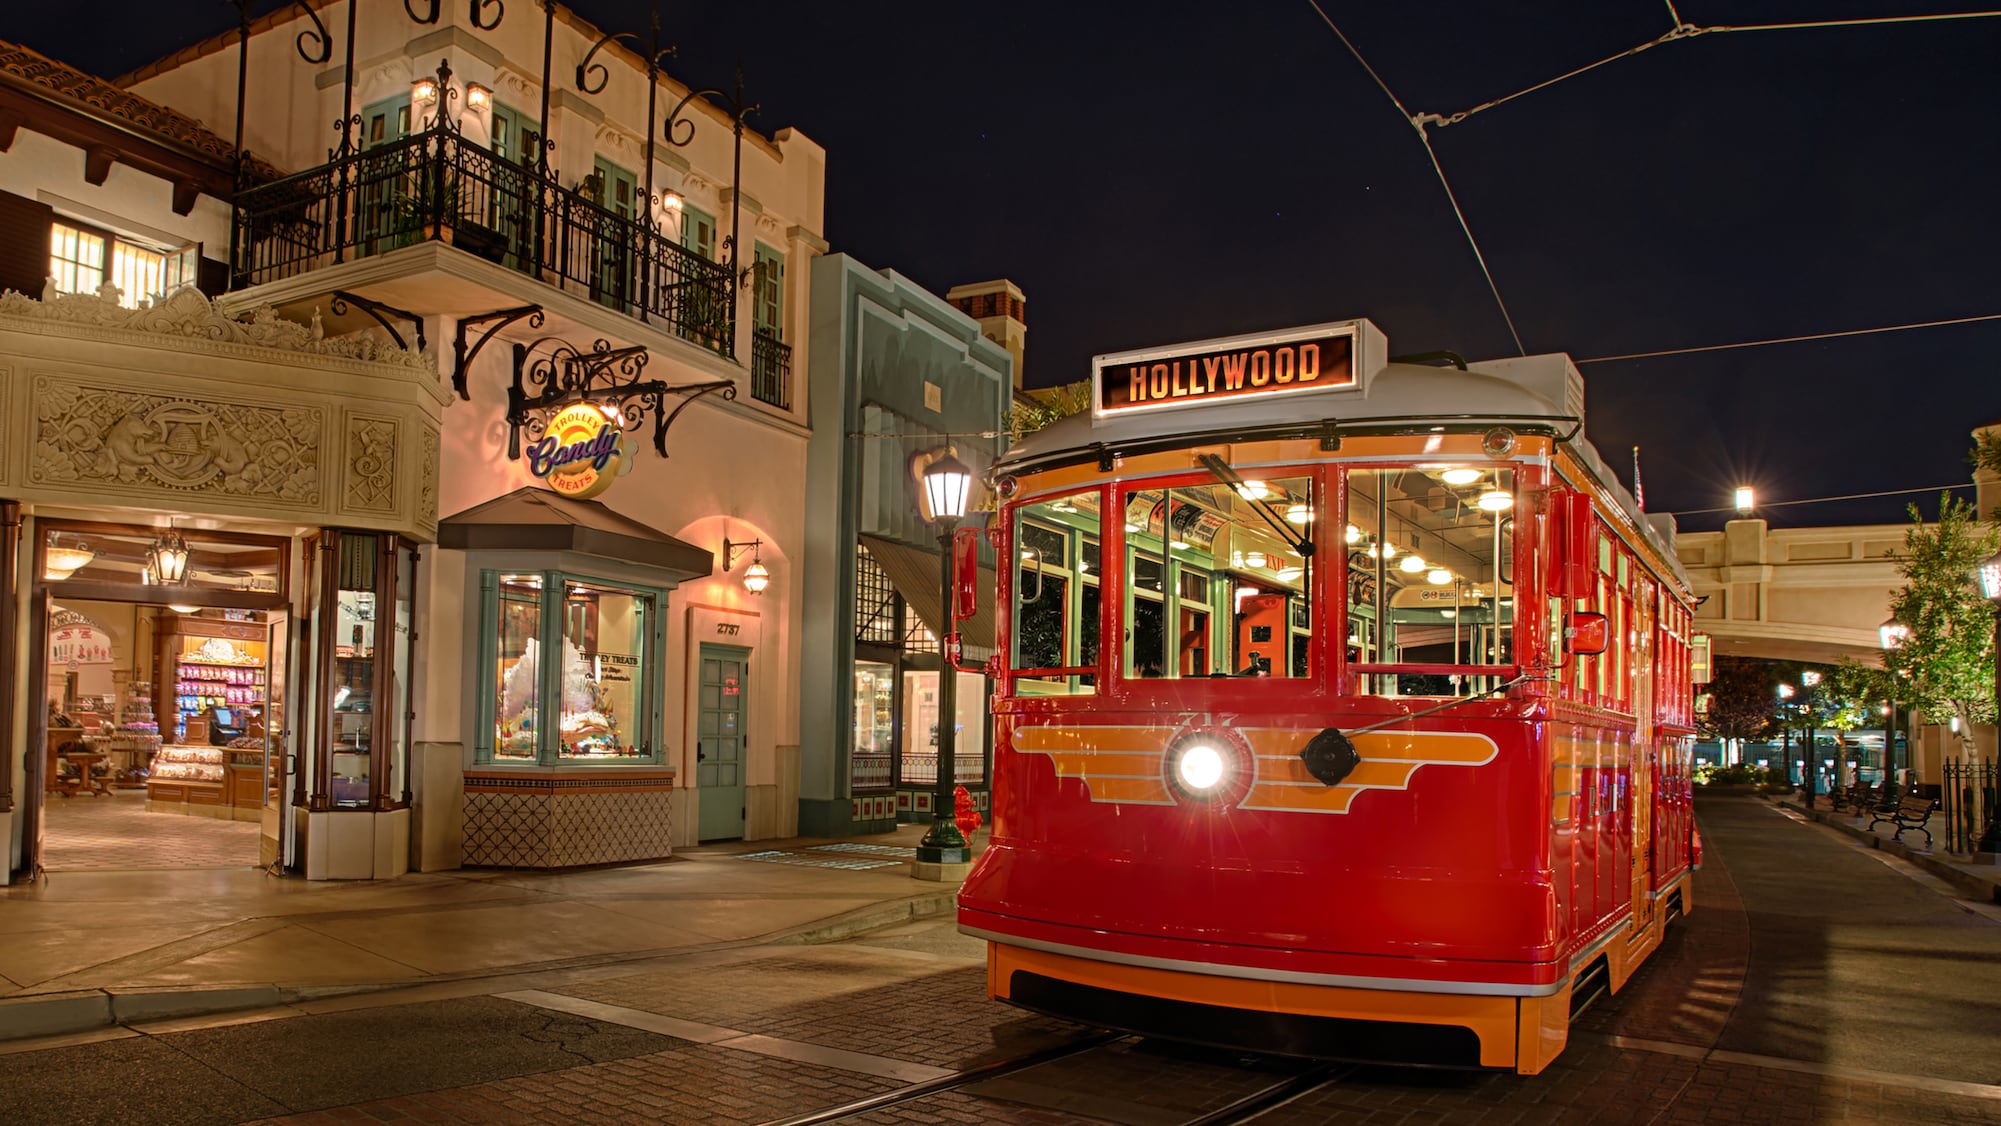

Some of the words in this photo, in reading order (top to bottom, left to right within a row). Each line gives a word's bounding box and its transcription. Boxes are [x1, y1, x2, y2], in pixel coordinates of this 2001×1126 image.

[1129, 343, 1321, 402] HOLLYWOOD
[554, 412, 600, 431] TROLLEY
[526, 422, 621, 476] Candy
[552, 473, 593, 491] TREATS
[1265, 552, 1287, 571] EXIT
[716, 622, 741, 636] 2737
[579, 652, 610, 663] TREY
[612, 655, 638, 665] TREATS
[1177, 711, 1239, 727] 717
